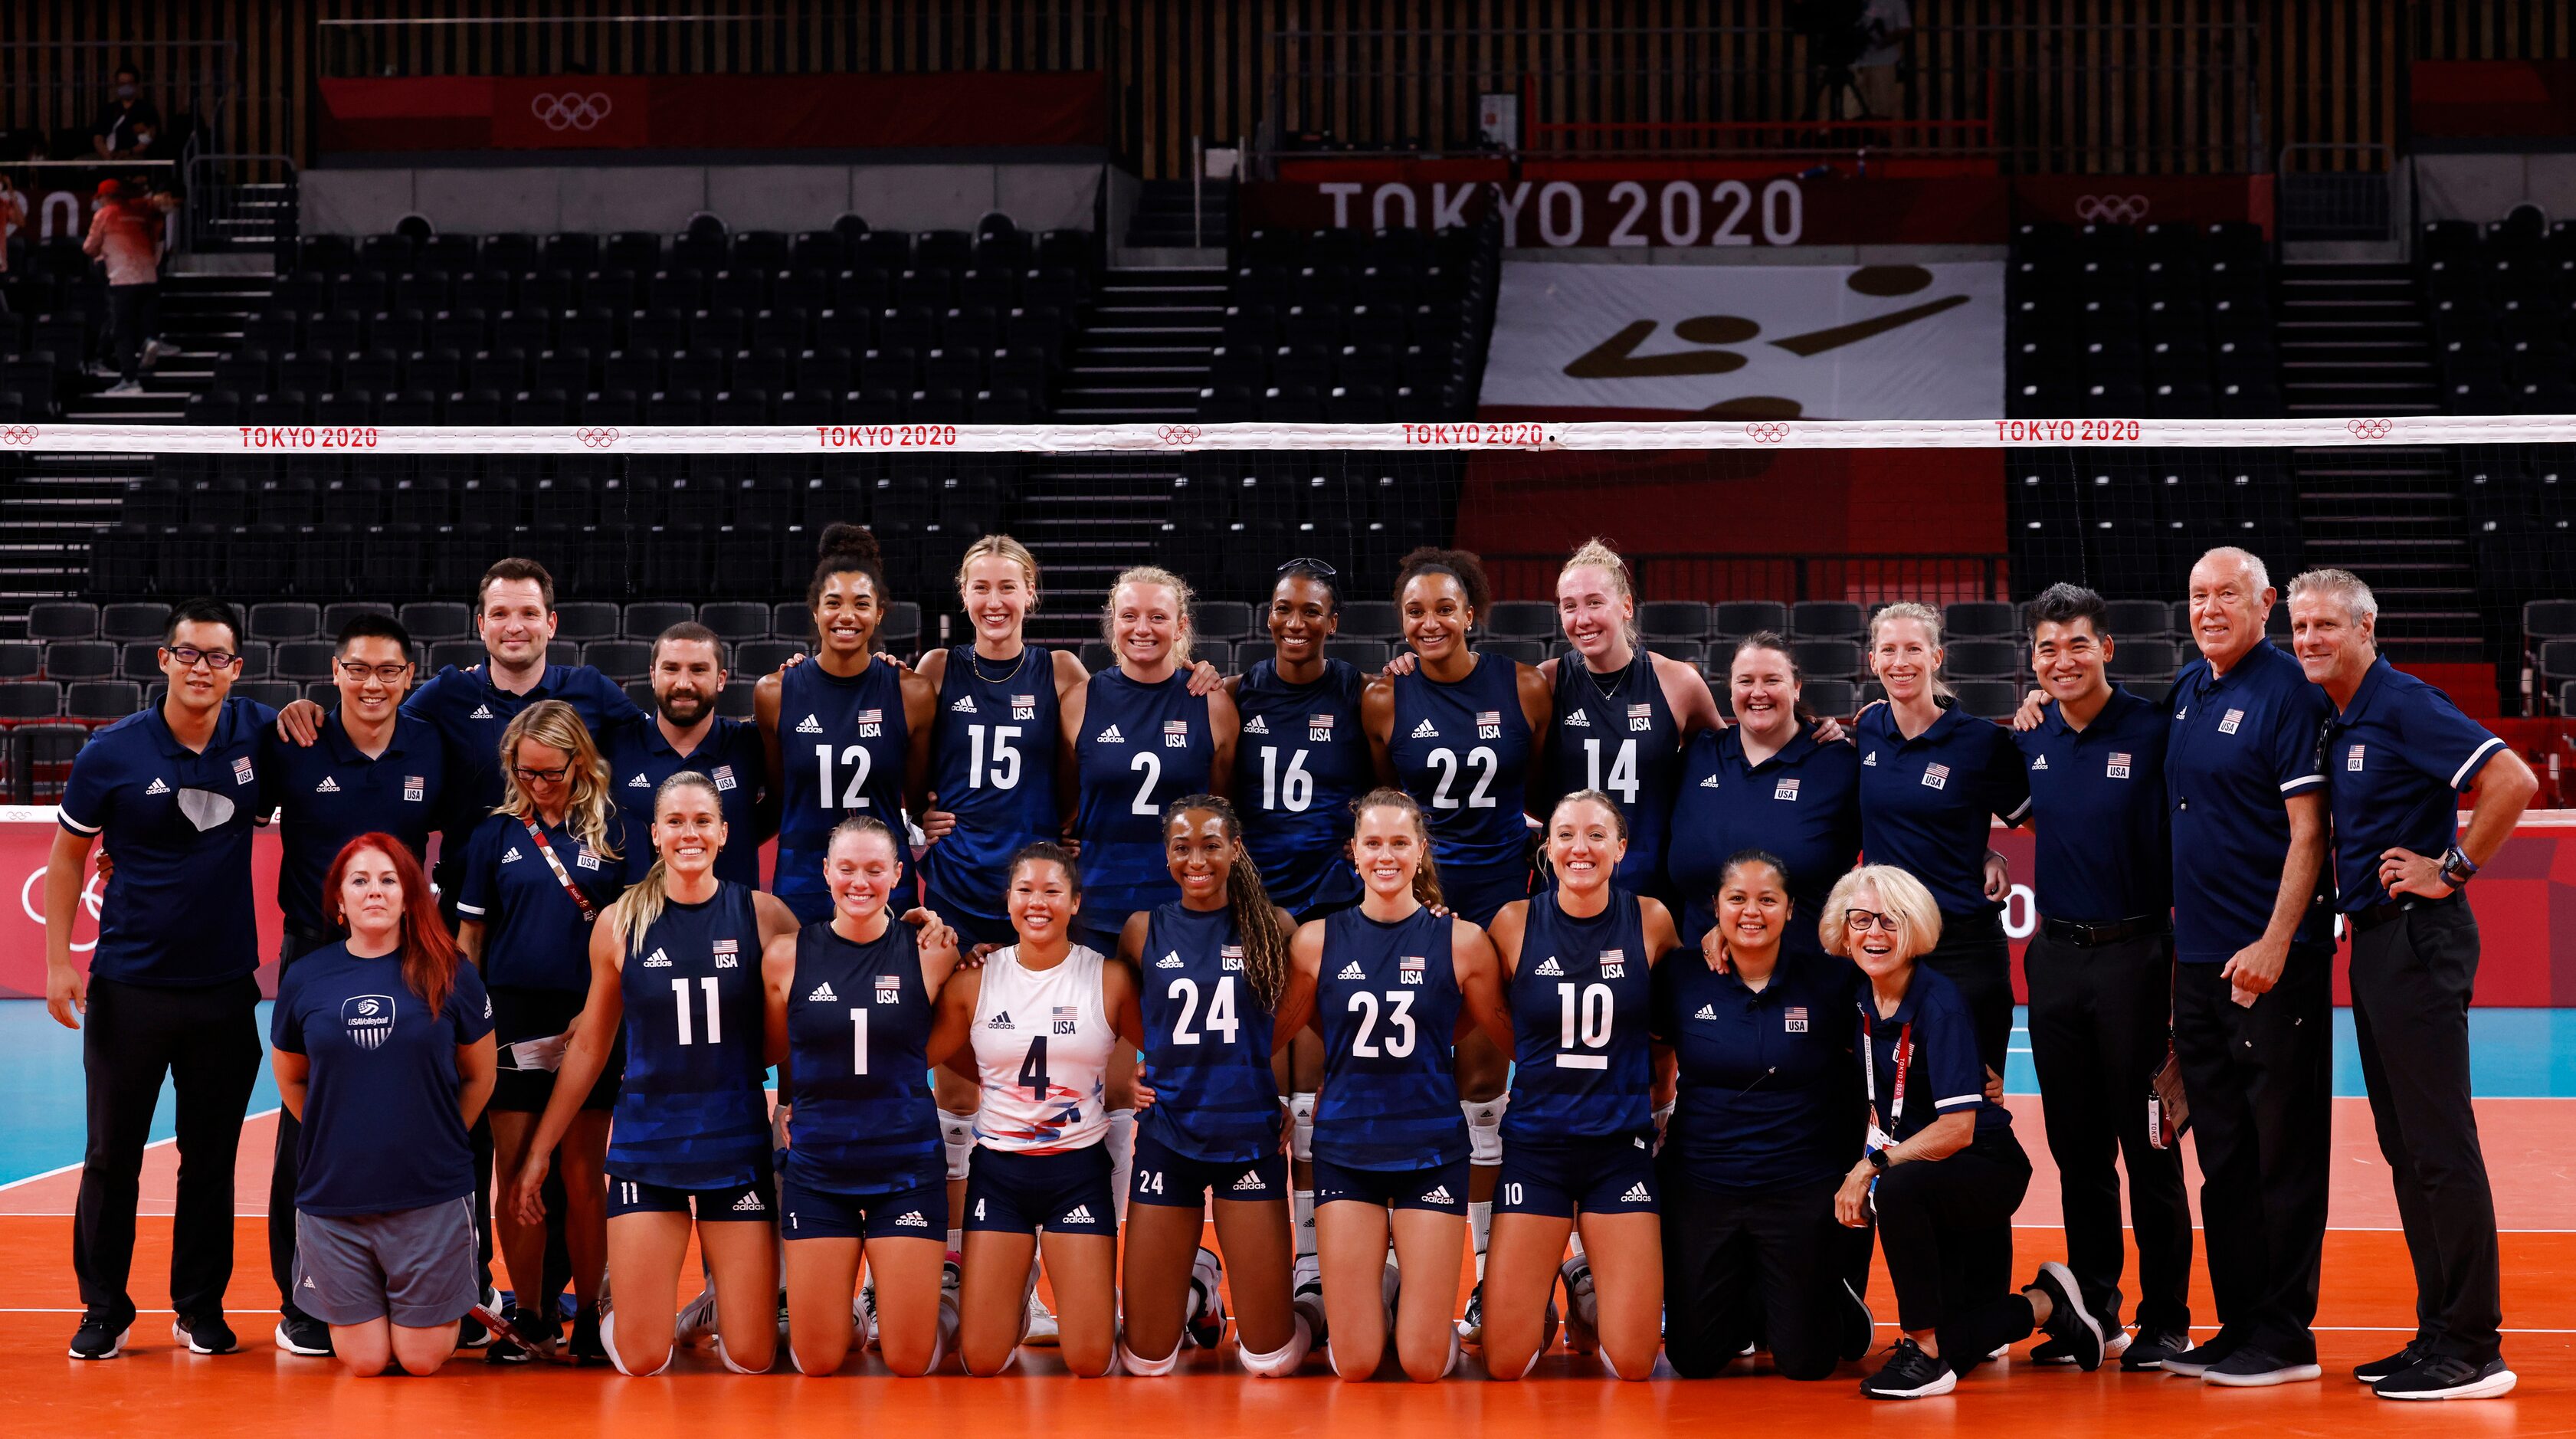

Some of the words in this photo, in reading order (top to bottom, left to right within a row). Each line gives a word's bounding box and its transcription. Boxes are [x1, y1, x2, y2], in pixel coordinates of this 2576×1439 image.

[1319, 180, 1583, 247] TOKYO
[1607, 179, 1803, 247] 2020
[239, 428, 315, 447] TOKYO
[322, 428, 377, 447] 2020
[817, 427, 893, 447] TOKYO
[900, 425, 955, 445] 2020
[1402, 424, 1480, 444] TOKYO
[1486, 424, 1542, 444] 2020
[1995, 421, 2074, 441] TOKYO
[2082, 420, 2138, 440] 2020
[1012, 706, 1035, 720] USA
[859, 723, 882, 738] USA
[1478, 725, 1501, 739] USA
[1629, 717, 1651, 732] USA
[2220, 722, 2234, 733] USA
[1165, 733, 1187, 748] USA
[1309, 727, 1332, 742] USA
[968, 724, 1022, 790] 15
[2349, 760, 2361, 769] USA
[239, 771, 252, 782] USA
[815, 744, 871, 808] 12
[1260, 746, 1313, 812] 16
[1427, 746, 1498, 809] 22
[1583, 739, 1639, 804] 14
[2110, 766, 2125, 776] USA
[719, 779, 734, 789] USA
[1130, 751, 1161, 815] 2
[1925, 775, 1942, 787] USA
[407, 790, 421, 800] USA
[1778, 790, 1793, 799] USA
[581, 858, 596, 868] USA
[715, 953, 738, 969] USA
[1222, 958, 1244, 971] USA
[1401, 970, 1424, 985] USA
[1601, 963, 1625, 980] USA
[876, 990, 899, 1005] USA
[671, 976, 721, 1045] 11
[1168, 975, 1239, 1045] 24
[1558, 982, 1614, 1049] 10
[1054, 1021, 1076, 1034] USA
[1348, 990, 1416, 1058] 23
[1788, 1021, 1804, 1031] USA
[850, 1008, 868, 1075] 1
[1018, 1035, 1050, 1101] 4
[1139, 1170, 1164, 1195] 24
[621, 1182, 638, 1205] 11
[1505, 1182, 1523, 1206] 10
[974, 1198, 986, 1221] 4
